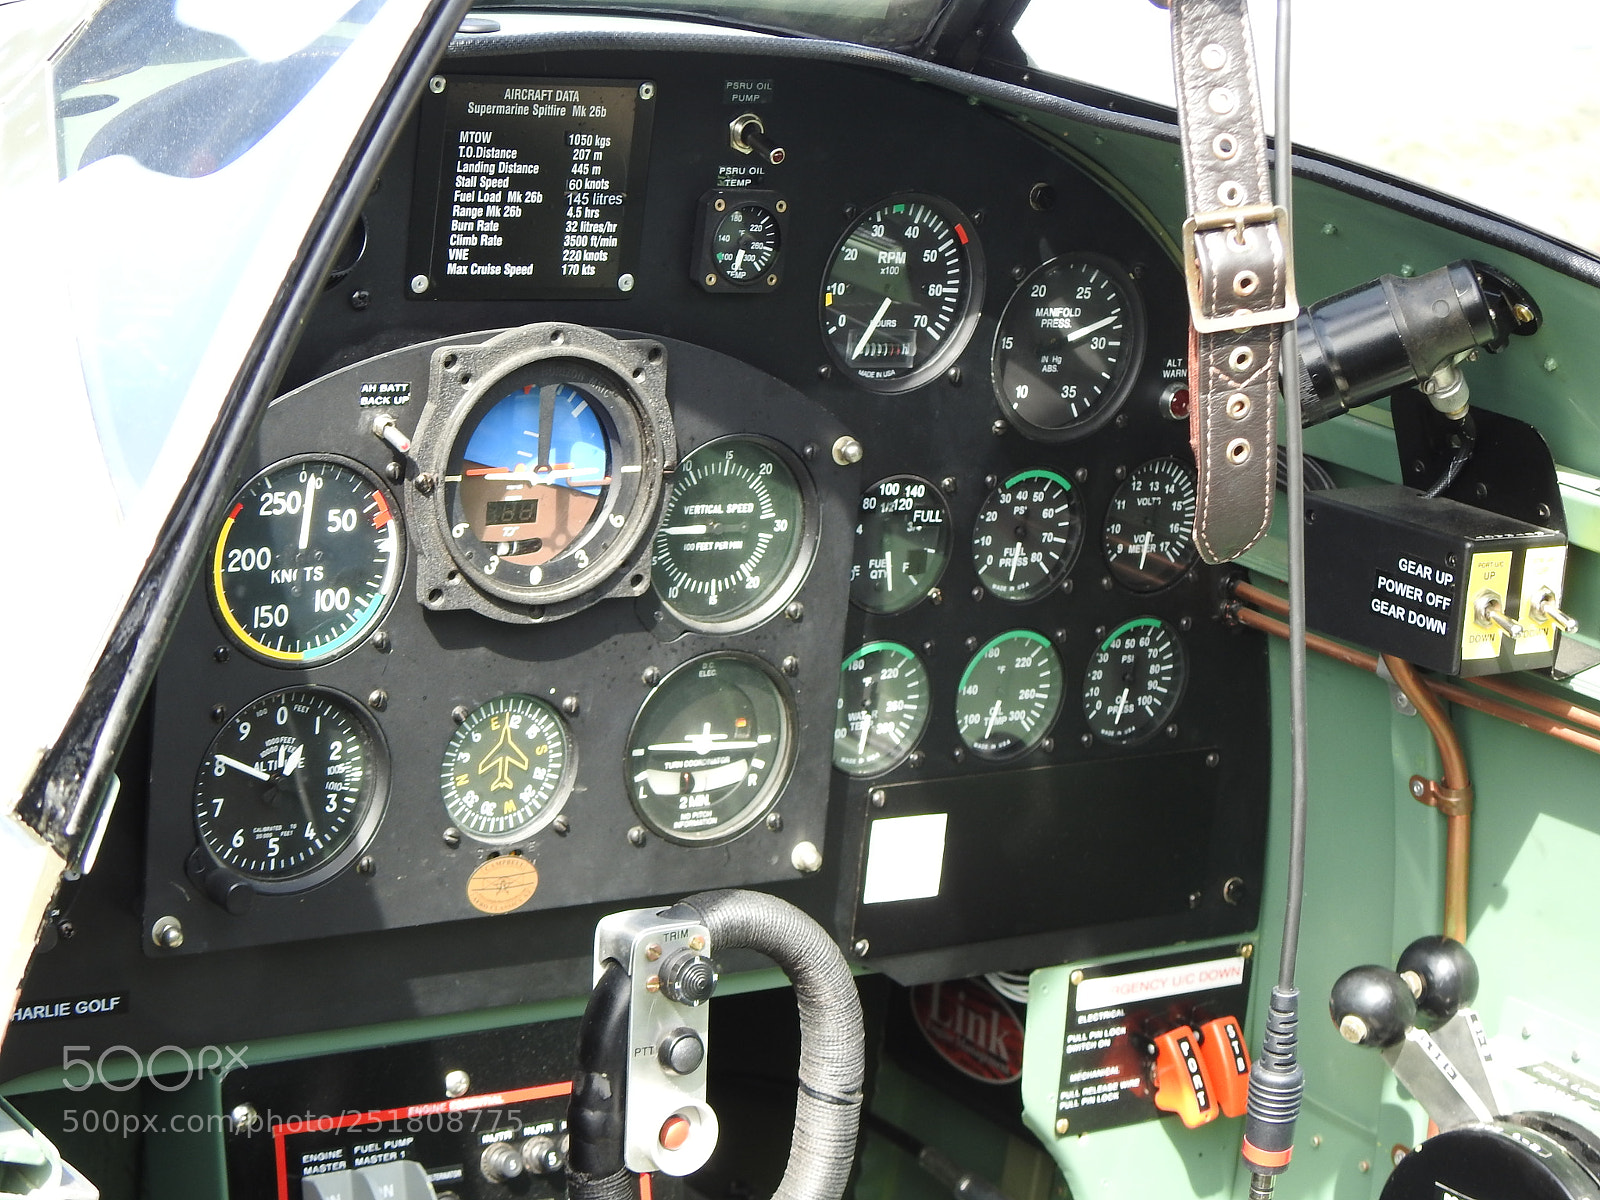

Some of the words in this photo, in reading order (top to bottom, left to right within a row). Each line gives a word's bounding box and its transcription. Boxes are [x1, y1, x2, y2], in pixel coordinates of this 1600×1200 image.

[727, 82, 753, 90] PSRU
[504, 88, 553, 100] AIRCRAFT
[556, 90, 580, 101] DATA
[732, 94, 760, 102] PUMP
[468, 102, 529, 116] Supermarine
[532, 104, 566, 117] Spitfire
[572, 106, 586, 116] Mk
[589, 106, 606, 117] 26b
[460, 131, 492, 143] MTOW
[569, 134, 592, 146] 1050
[595, 135, 610, 148] kgs
[459, 146, 517, 159] T.O.Distance
[573, 149, 591, 160] 207
[593, 152, 602, 160] m
[457, 161, 495, 175] Landing
[498, 162, 539, 174] Distance
[572, 164, 589, 175] 445
[592, 166, 601, 175] m
[719, 167, 746, 175] PSRU
[749, 167, 765, 175] OIL
[456, 176, 477, 188] Stall
[480, 177, 509, 189] Speed
[569, 179, 582, 190] 60
[585, 178, 609, 190] knots
[454, 191, 475, 202] Fuel
[478, 191, 501, 202] Load
[507, 192, 521, 203] Mk
[525, 192, 543, 203] 26b
[567, 194, 589, 205] 145
[593, 193, 623, 205] litres
[453, 205, 483, 219] Range
[486, 206, 501, 217] Mk
[503, 206, 521, 217] 26b
[567, 207, 581, 218] 4.5
[584, 207, 599, 218] hrs
[451, 220, 474, 231] Burn
[477, 220, 499, 232] Rate
[566, 222, 577, 232] 32
[580, 221, 617, 233] litres/hr
[871, 225, 884, 237] 30
[905, 226, 919, 238] 40
[450, 234, 477, 246] Climb
[480, 235, 502, 246] Rate
[564, 236, 587, 247] 3500
[590, 236, 617, 248] ft/min
[449, 249, 469, 261] VNE
[563, 250, 581, 261] 220
[583, 250, 608, 262] knots
[844, 249, 857, 260] 20
[878, 252, 906, 264] RPM
[923, 250, 937, 262] 50
[447, 264, 468, 275] Max
[471, 264, 501, 275] Cruise
[504, 264, 533, 277] Speed
[562, 264, 579, 275] 170
[581, 264, 595, 276] kts
[880, 267, 899, 275] x100
[831, 283, 845, 295] 10
[928, 284, 942, 296] 60
[1031, 285, 1046, 297] 20
[1076, 287, 1091, 299] 25
[1036, 308, 1081, 317] MANIFOLD
[838, 315, 846, 327] 0
[914, 315, 928, 327] 70
[1002, 337, 1013, 349] 15
[1091, 337, 1105, 349] 30
[1052, 356, 1062, 364] Hg
[1167, 359, 1182, 367] ALT
[1163, 369, 1187, 378] WARN
[361, 384, 376, 393] AH
[379, 383, 408, 393] BATT
[1016, 385, 1028, 398] 10
[1061, 386, 1077, 398] 35
[361, 396, 390, 406] BACK
[393, 395, 409, 405] UP
[726, 451, 734, 459] 15
[760, 463, 772, 474] 20
[880, 483, 899, 496] 100
[905, 485, 925, 498] 140
[1165, 484, 1174, 494] 14
[260, 491, 301, 516] 250
[684, 503, 724, 515] VERTICAL
[726, 503, 754, 514] SPEED
[863, 498, 876, 510] 80
[894, 498, 913, 511] 120
[1172, 501, 1182, 511] 15
[913, 510, 942, 523] FULL
[986, 511, 997, 521] 20
[1042, 508, 1054, 518] 60
[327, 509, 357, 532] 50
[774, 519, 787, 531] 30
[1170, 523, 1179, 533] 16
[980, 536, 992, 546] 10
[1042, 533, 1053, 543] 70
[228, 547, 271, 572] 200
[1399, 557, 1432, 581] GEAR
[1435, 572, 1453, 586] UP
[1484, 572, 1495, 580] UP
[315, 587, 349, 612] 100
[1378, 576, 1423, 601] POWER
[1426, 592, 1451, 611] OFF
[254, 604, 288, 628] 150
[1371, 599, 1405, 622] GEAR
[1408, 612, 1446, 636] DOWN
[1139, 637, 1150, 647] 60
[1469, 634, 1495, 644] DOWN
[1015, 657, 1032, 668] 220
[1092, 670, 1102, 680] 20
[1150, 664, 1160, 674] 80
[1019, 689, 1035, 700] 260
[276, 706, 288, 725] 0
[294, 705, 310, 714] FEET
[315, 716, 320, 734] 1
[491, 717, 500, 730] E
[239, 723, 251, 741] 9
[329, 741, 342, 760] 2
[536, 745, 548, 755] S
[747, 774, 758, 787] R
[639, 786, 648, 799] L
[212, 799, 224, 817] 7
[325, 794, 337, 813] 3
[304, 822, 316, 840] 4
[267, 838, 279, 857] 5
[663, 929, 689, 942] TRIM
[1199, 967, 1241, 982] DOWN
[10, 1002, 71, 1022] HARLIE
[75, 997, 120, 1015] GOLF
[1078, 1009, 1125, 1024] ELECTRICAL
[634, 1046, 654, 1057] PTT
[1180, 1041, 1205, 1106] PORT
[354, 1144, 381, 1156] FUEL
[384, 1137, 414, 1151] PUMP
[303, 1150, 342, 1163] ENGINE
[355, 1153, 395, 1167] MASTER
[303, 1161, 346, 1176] MASTER
